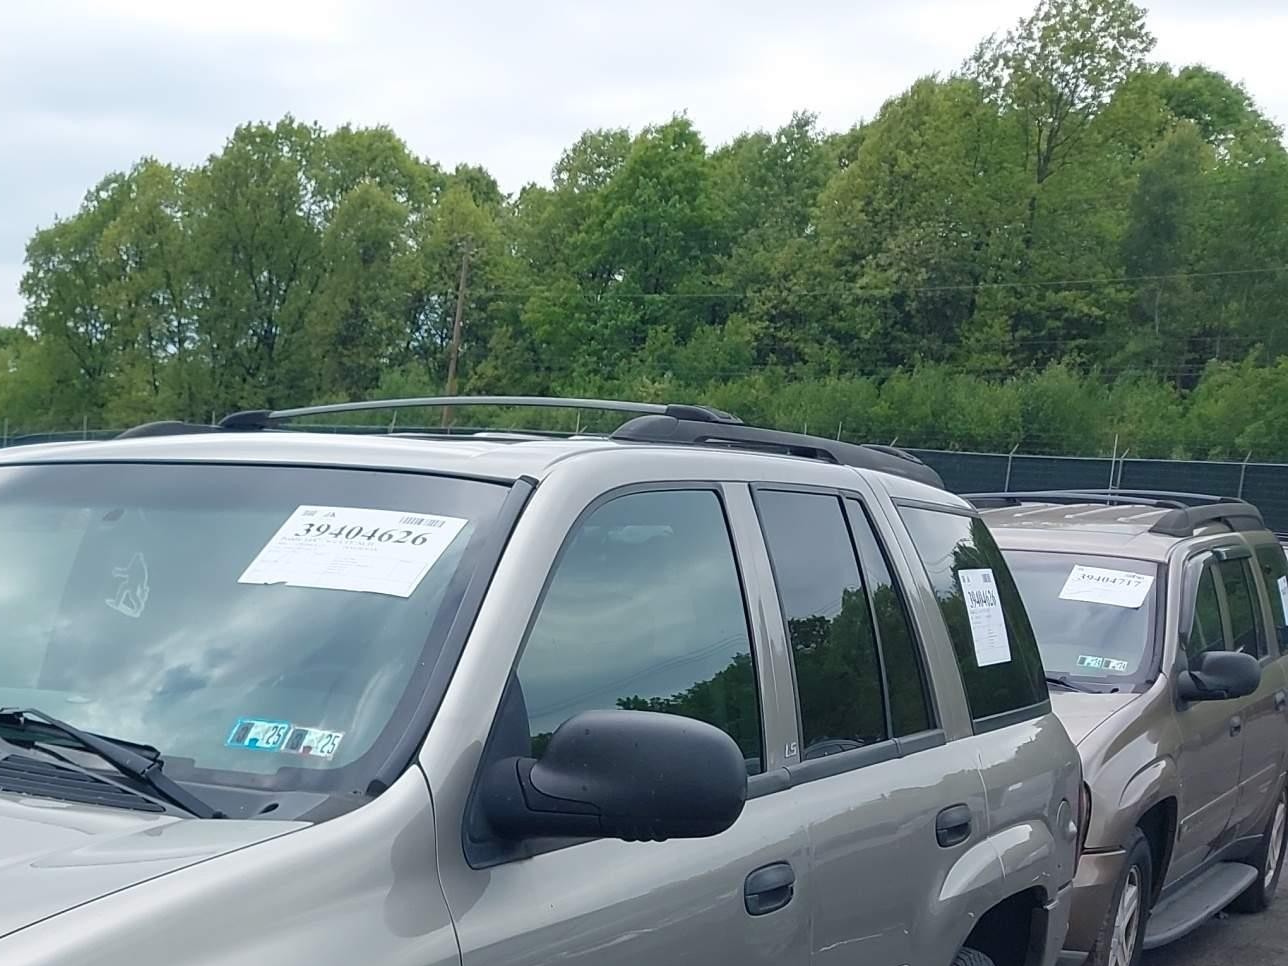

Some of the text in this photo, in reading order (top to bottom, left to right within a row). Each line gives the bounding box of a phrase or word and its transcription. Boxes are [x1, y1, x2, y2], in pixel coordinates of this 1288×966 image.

[294, 522, 433, 547] 39404626
[1078, 572, 1142, 588] 39404717
[265, 725, 286, 746] 25
[319, 733, 341, 755] 25
[785, 742, 797, 758] LS
